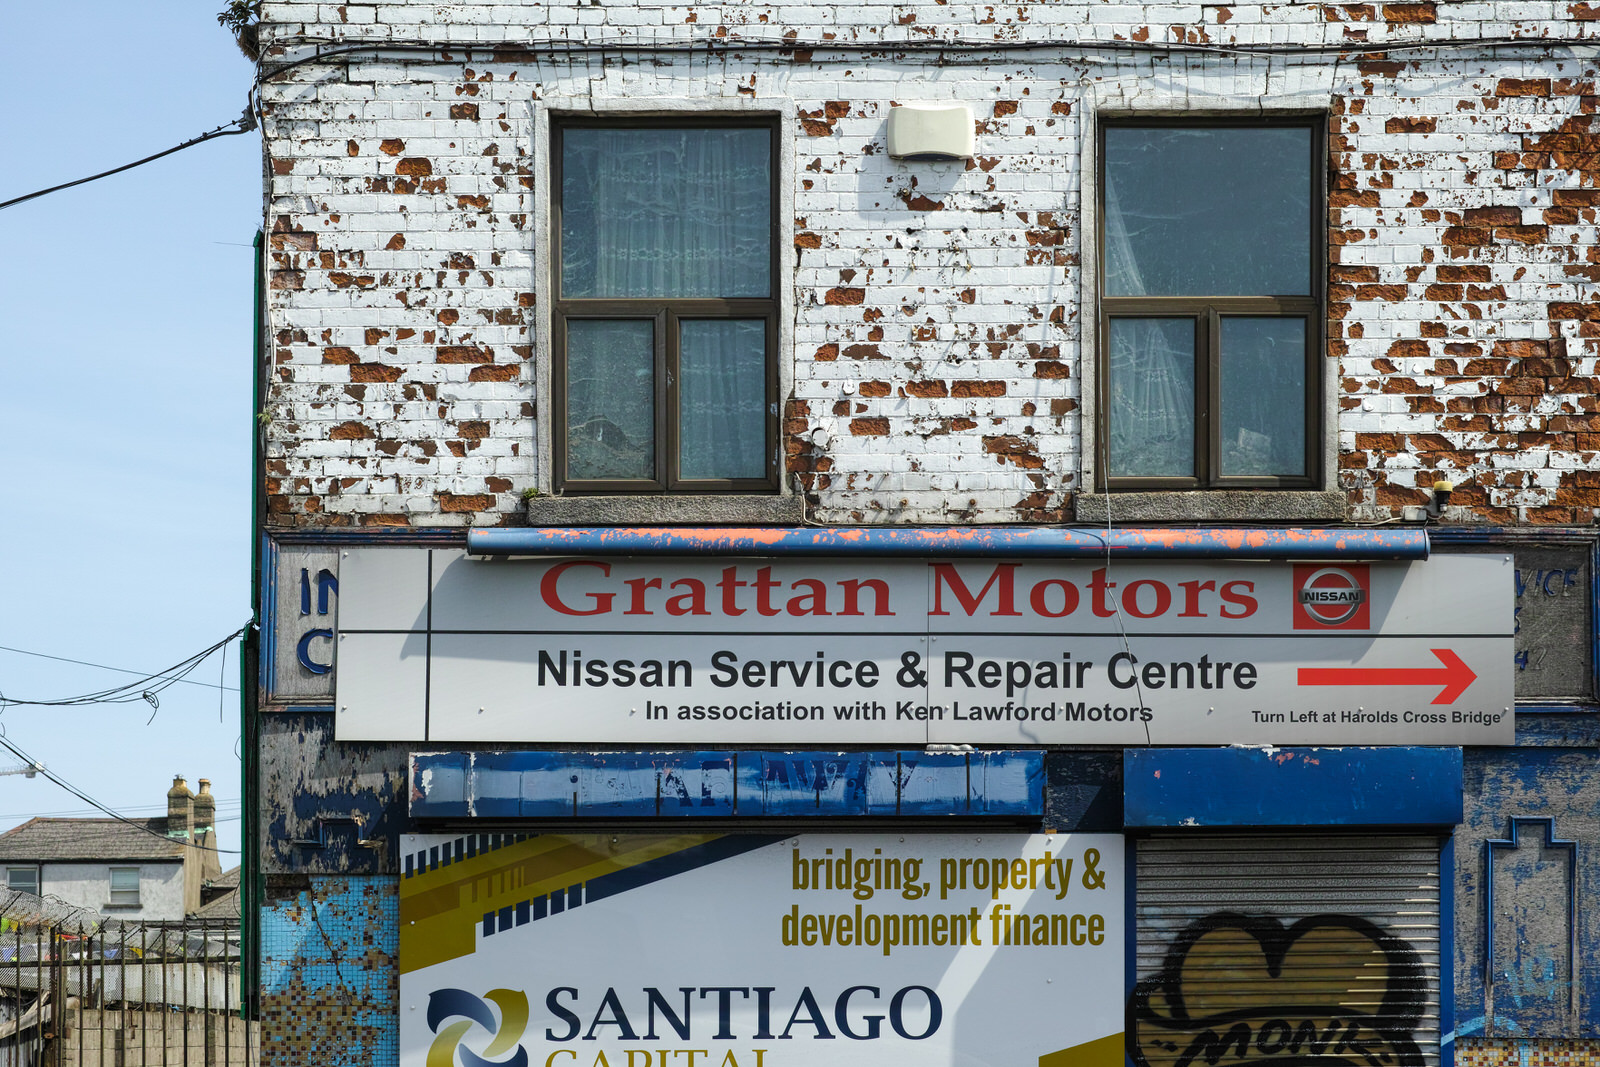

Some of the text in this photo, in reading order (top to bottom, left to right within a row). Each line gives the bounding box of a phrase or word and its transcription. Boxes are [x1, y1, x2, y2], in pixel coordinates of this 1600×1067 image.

[540, 560, 1259, 619] Grattan Motors
[1304, 591, 1359, 602] NISSAN
[537, 650, 1257, 698] Nissan Service & Repair Centre
[646, 701, 1153, 722] In association with Ken Lawford Motors
[1252, 711, 1501, 726] Turn Left at Harolds Cross Bridge
[792, 848, 1105, 900] bridging, property &
[782, 904, 1105, 956] development finance
[545, 985, 943, 1042] SANTIAGO
